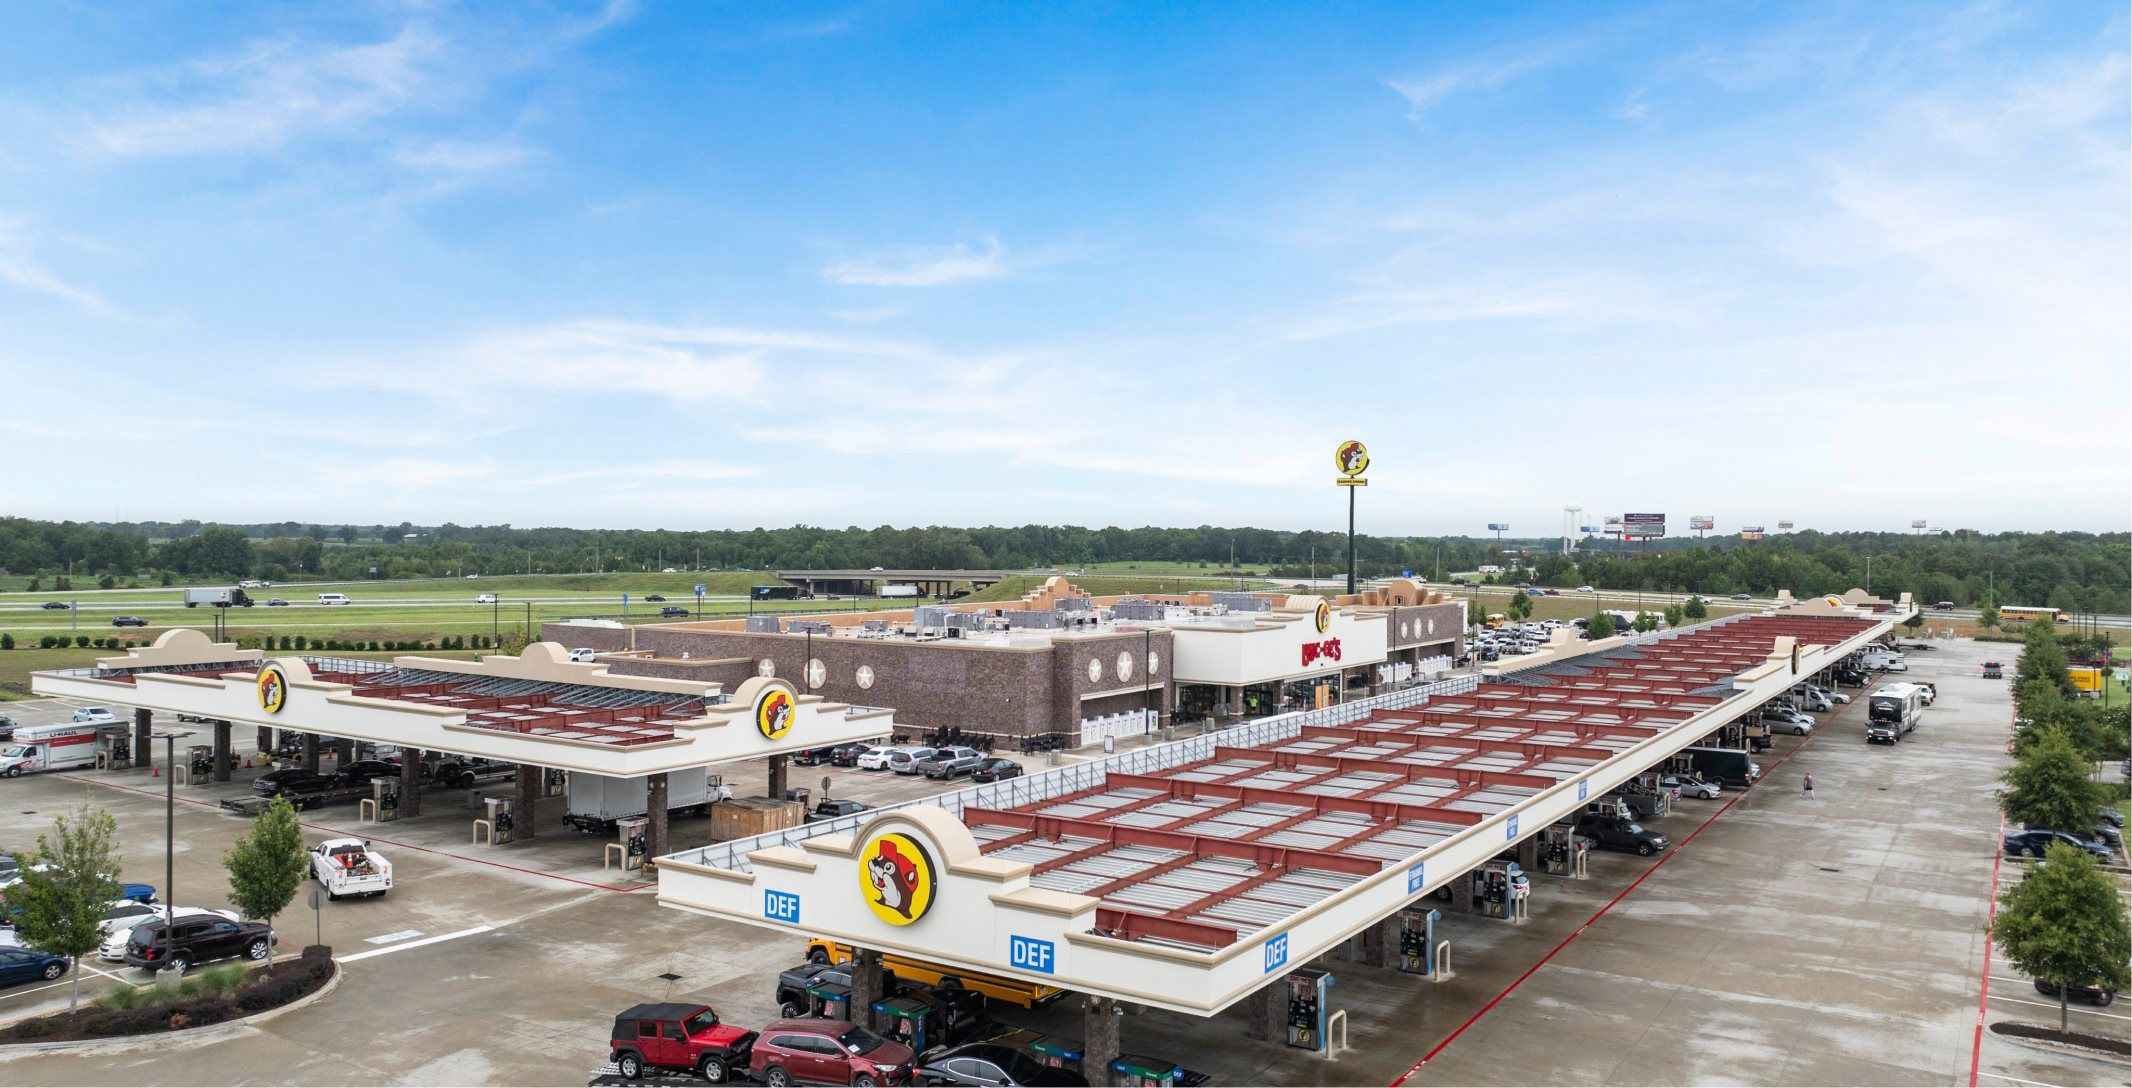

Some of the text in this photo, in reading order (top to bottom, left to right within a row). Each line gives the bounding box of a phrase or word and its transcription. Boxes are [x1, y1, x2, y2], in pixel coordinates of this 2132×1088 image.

[767, 893, 797, 918] DEF
[1013, 939, 1051, 968] DEF
[1266, 936, 1287, 969] DEF
